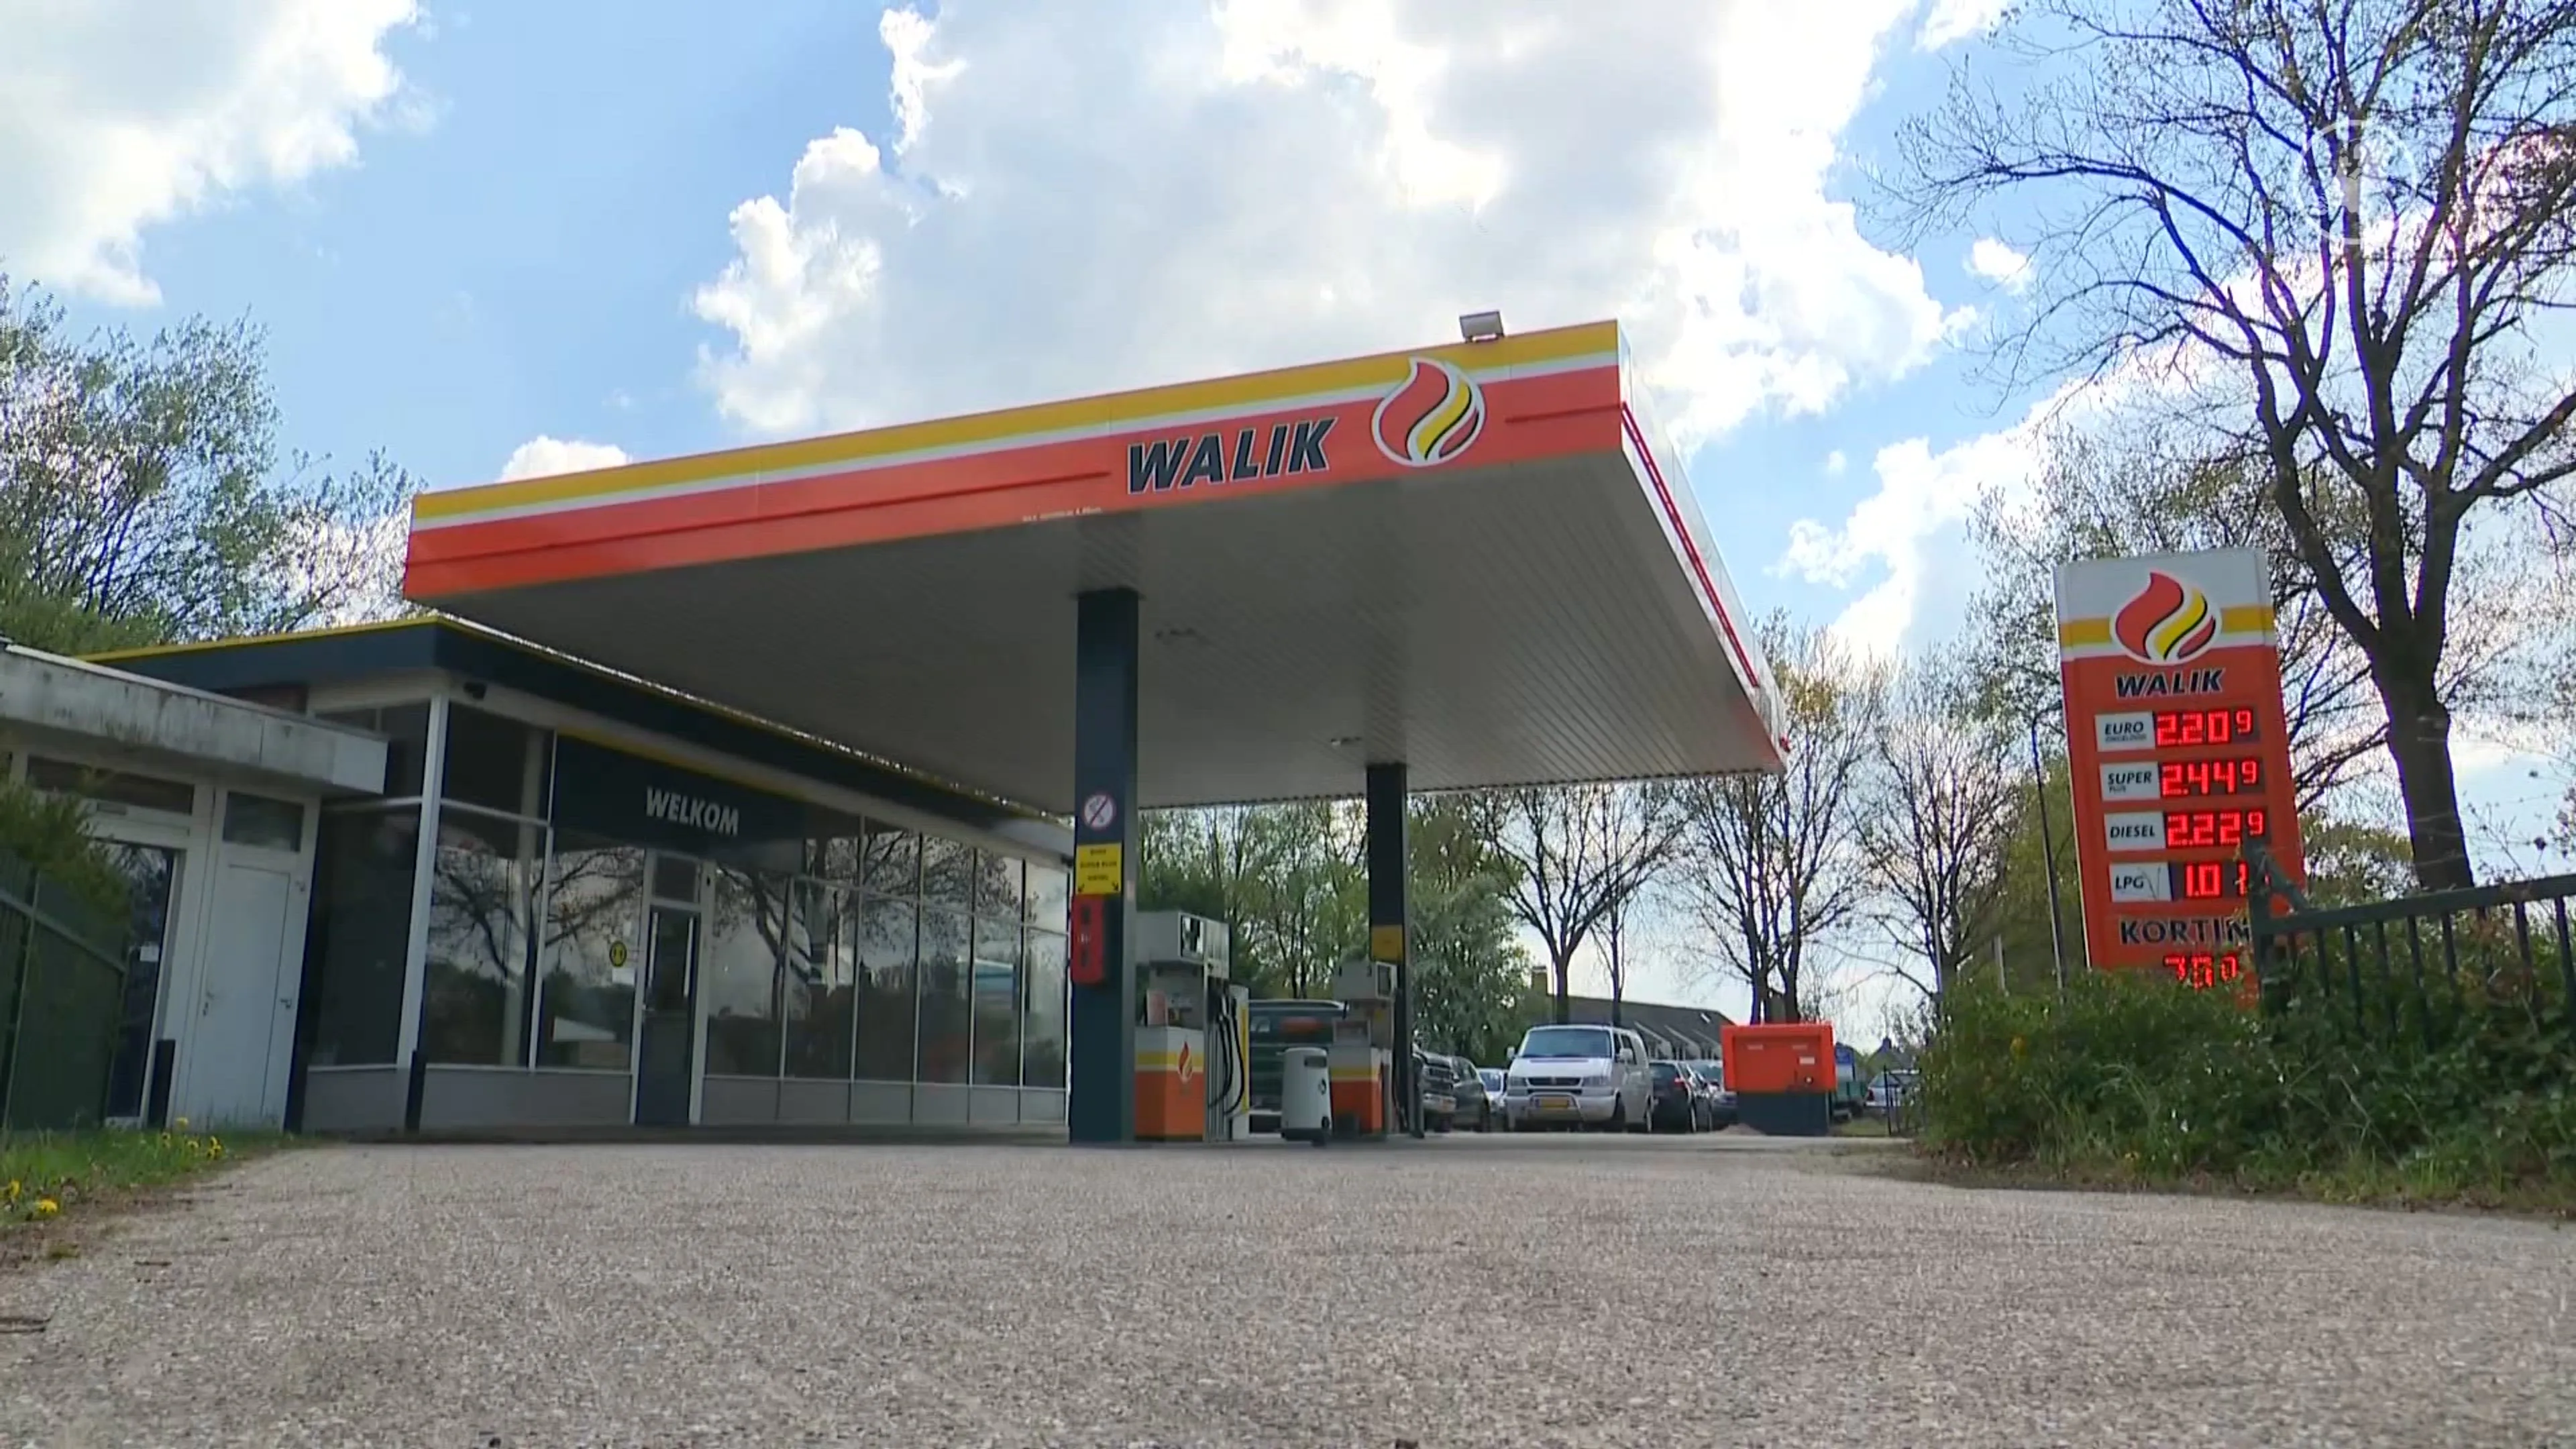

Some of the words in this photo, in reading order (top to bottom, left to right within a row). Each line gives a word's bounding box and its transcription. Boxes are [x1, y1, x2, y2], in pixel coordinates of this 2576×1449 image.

[1128, 417, 1338, 494] WALIK
[2115, 667, 2226, 700] WALIK
[2104, 721, 2144, 735] EURO
[2107, 771, 2152, 785] SUPER
[646, 786, 739, 837] WELKOM
[2109, 824, 2156, 839] DIESEL
[2114, 875, 2145, 890] LPG
[2186, 863, 2269, 897] 1.01
[2120, 916, 2252, 945] KORTIN
